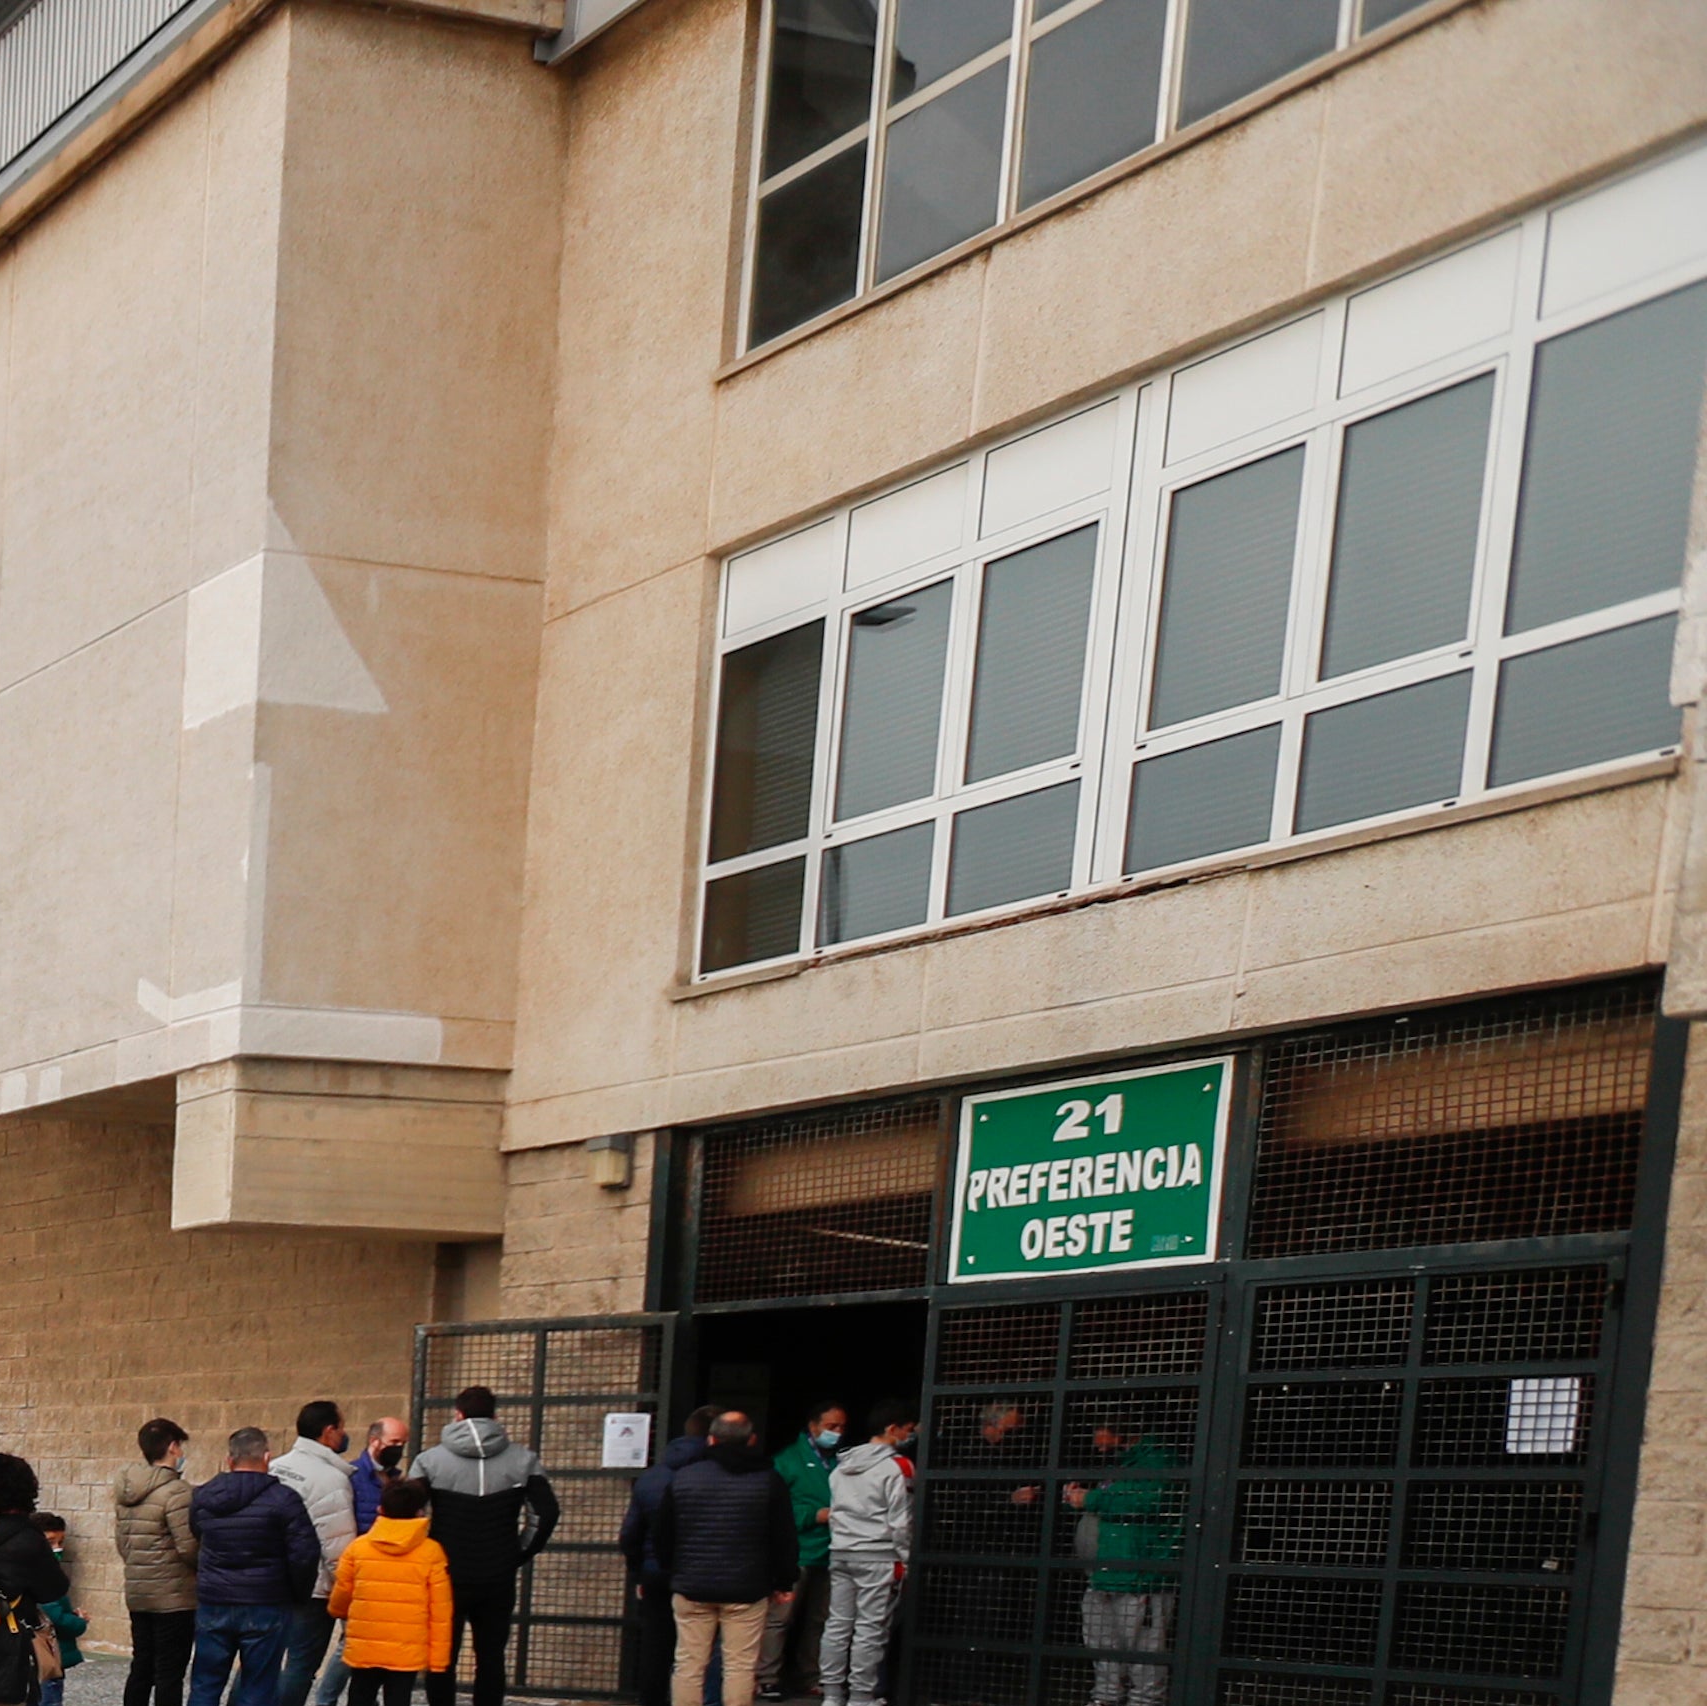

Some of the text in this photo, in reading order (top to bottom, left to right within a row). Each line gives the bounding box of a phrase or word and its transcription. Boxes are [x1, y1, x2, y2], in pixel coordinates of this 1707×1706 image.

[1053, 1093, 1124, 1142] 21
[967, 1143, 1202, 1212] PREFERENCIA
[1020, 1209, 1134, 1261] OESTE
